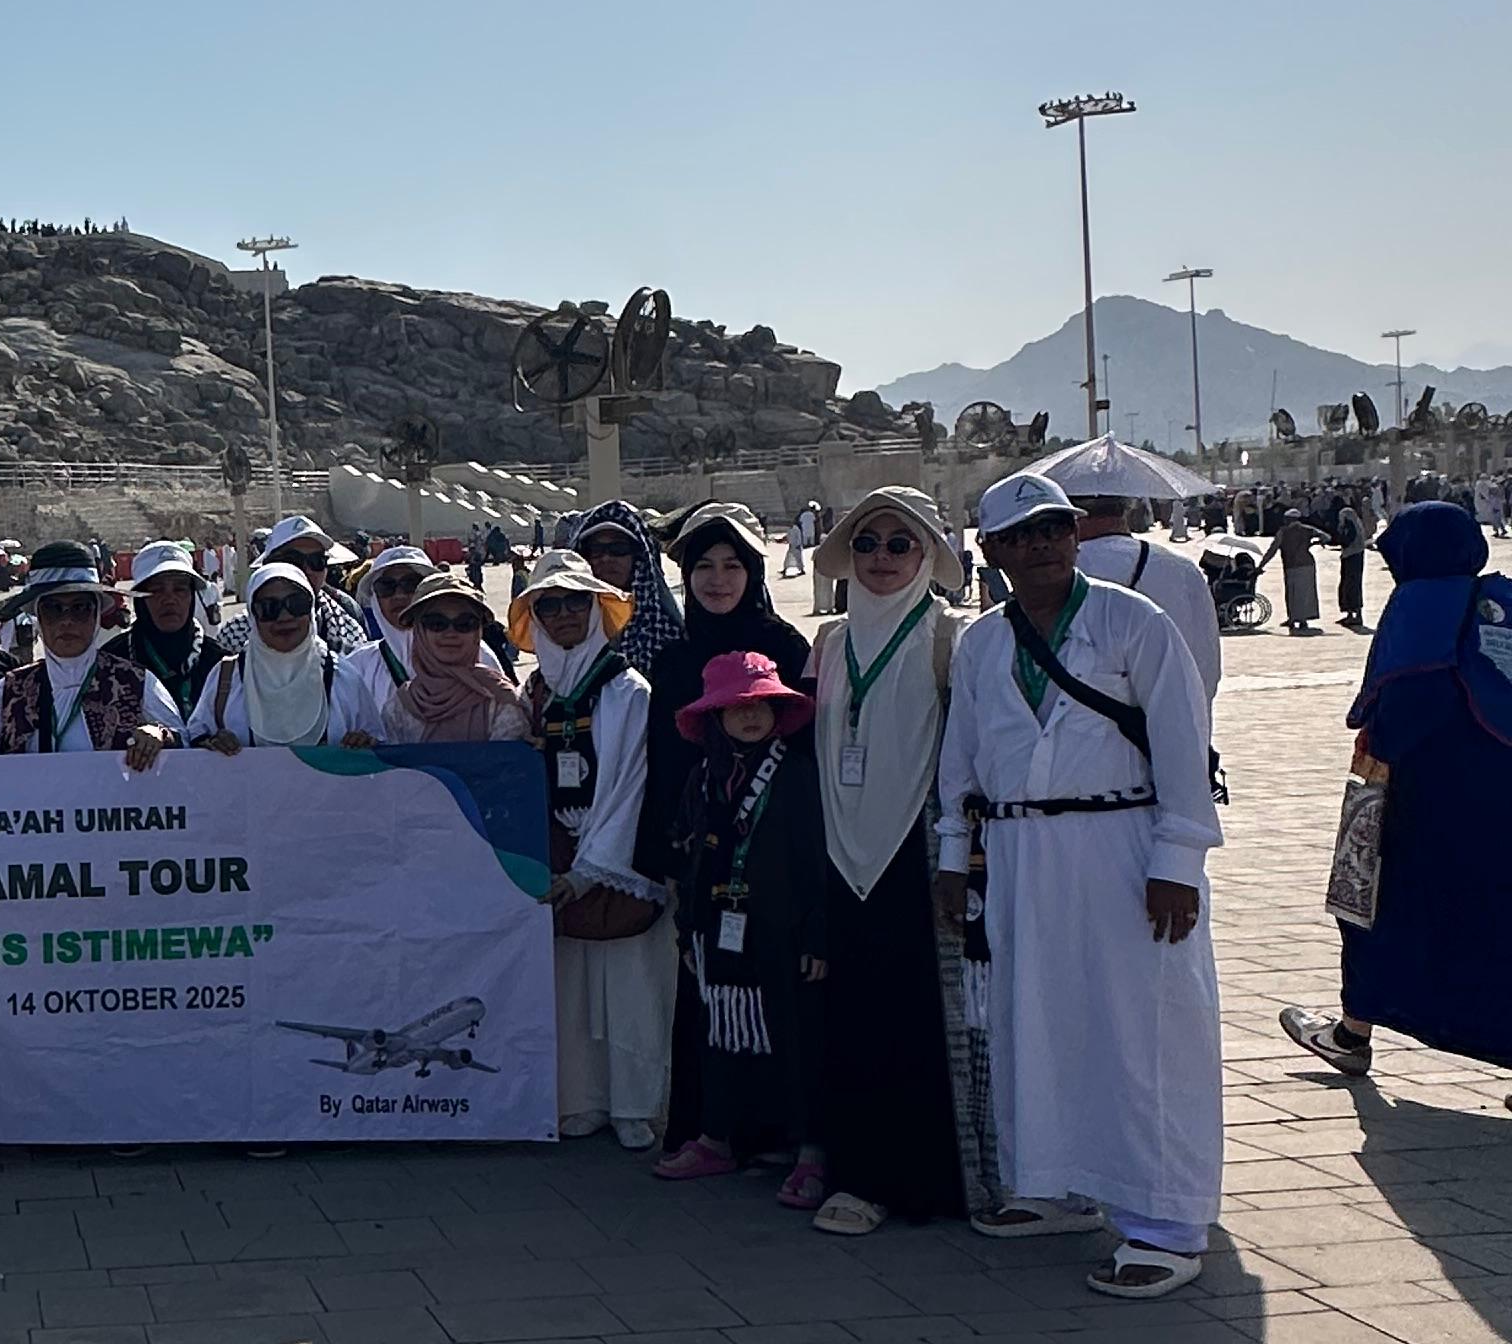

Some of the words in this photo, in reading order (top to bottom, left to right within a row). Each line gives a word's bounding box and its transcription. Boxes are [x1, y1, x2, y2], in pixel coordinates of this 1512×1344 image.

[74, 806, 186, 832] UMRAH
[118, 857, 251, 896] TOUR
[7, 992, 36, 1015] 14
[43, 987, 178, 1014] OKTOBER
[185, 985, 246, 1009] 2025
[319, 1094, 342, 1118] By
[352, 1094, 398, 1114] Qatar
[402, 1094, 470, 1118] Airways
